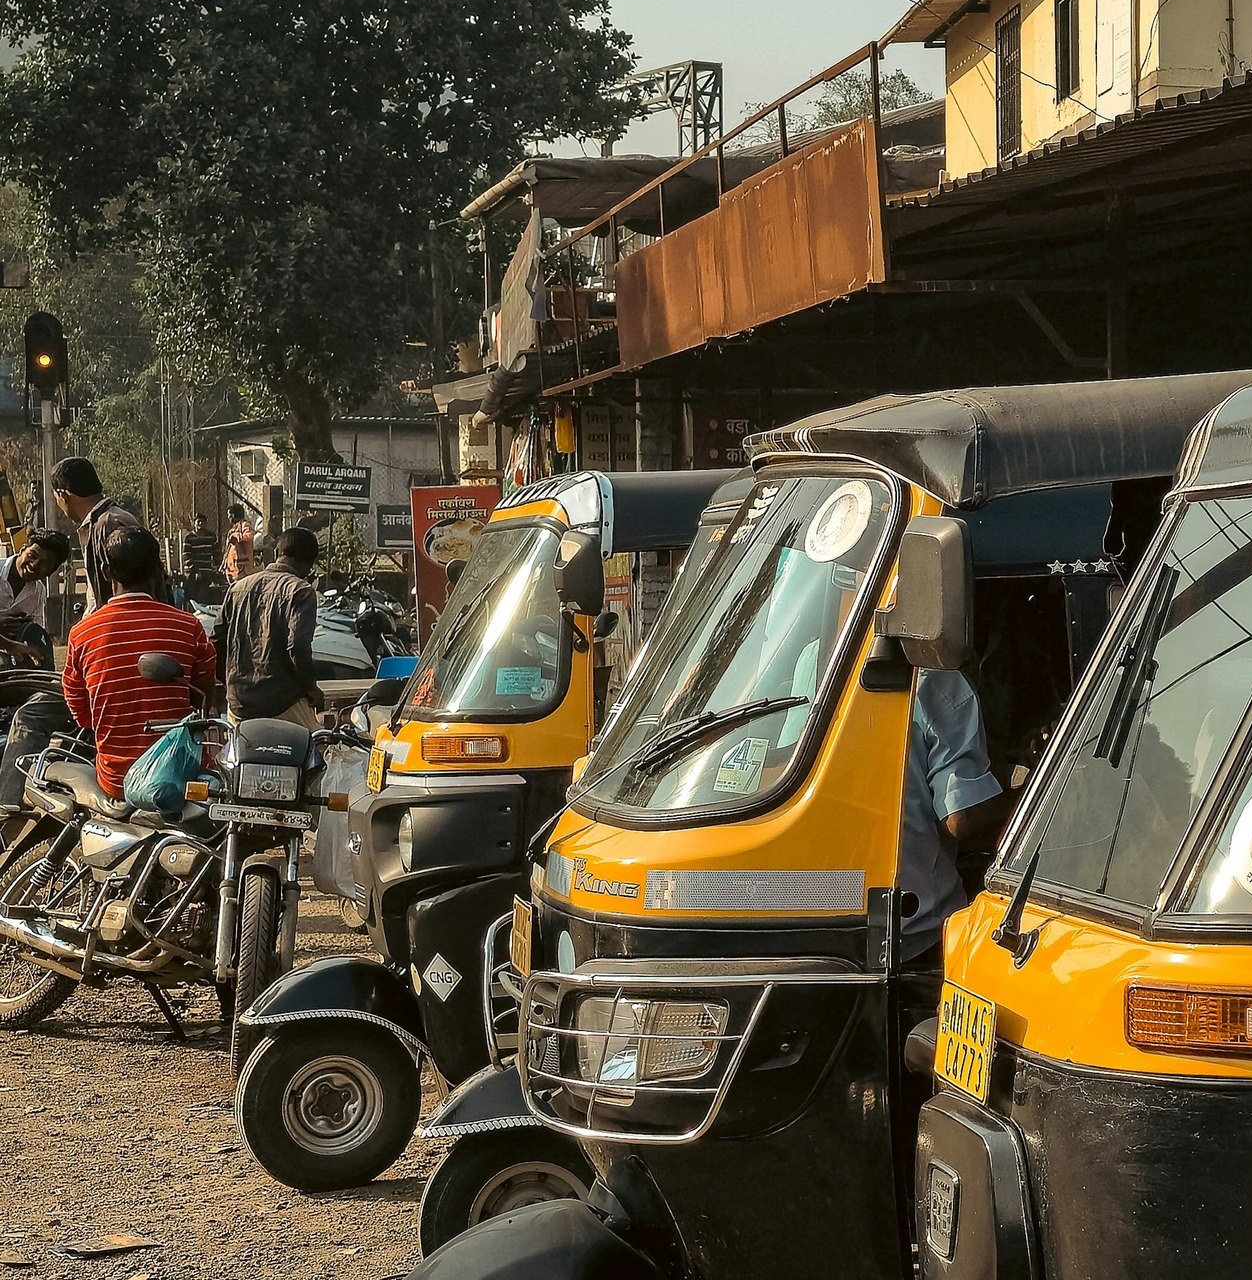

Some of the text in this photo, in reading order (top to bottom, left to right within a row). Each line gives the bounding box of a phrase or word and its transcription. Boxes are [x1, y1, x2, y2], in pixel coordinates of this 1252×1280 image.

[304, 465, 366, 479] DARUL ARQAM
[429, 971, 453, 984] CNG
